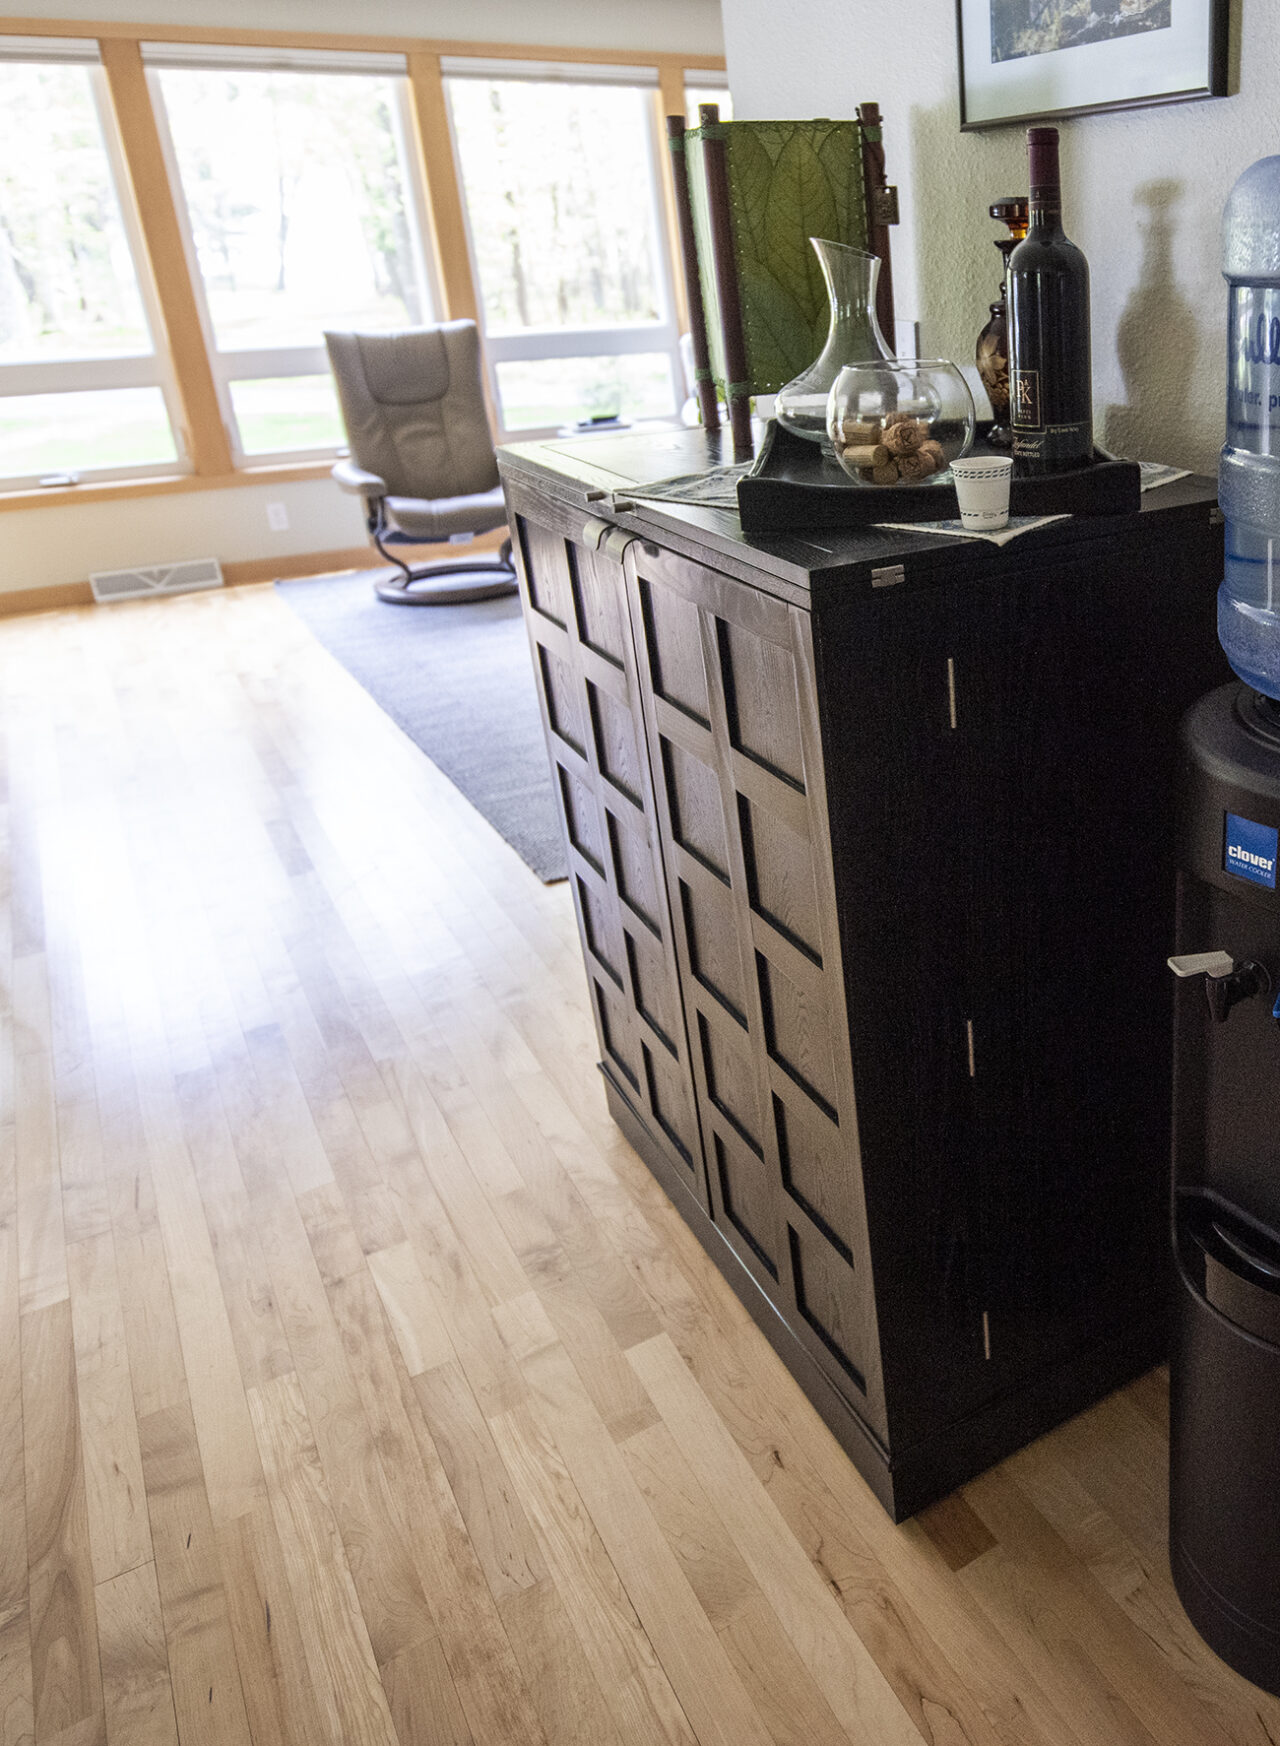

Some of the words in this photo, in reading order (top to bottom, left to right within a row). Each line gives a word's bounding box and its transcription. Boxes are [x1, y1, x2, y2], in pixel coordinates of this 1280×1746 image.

[1228, 845, 1273, 871] clover
[1229, 859, 1248, 870] WATER
[1248, 865, 1272, 879] COOLER
